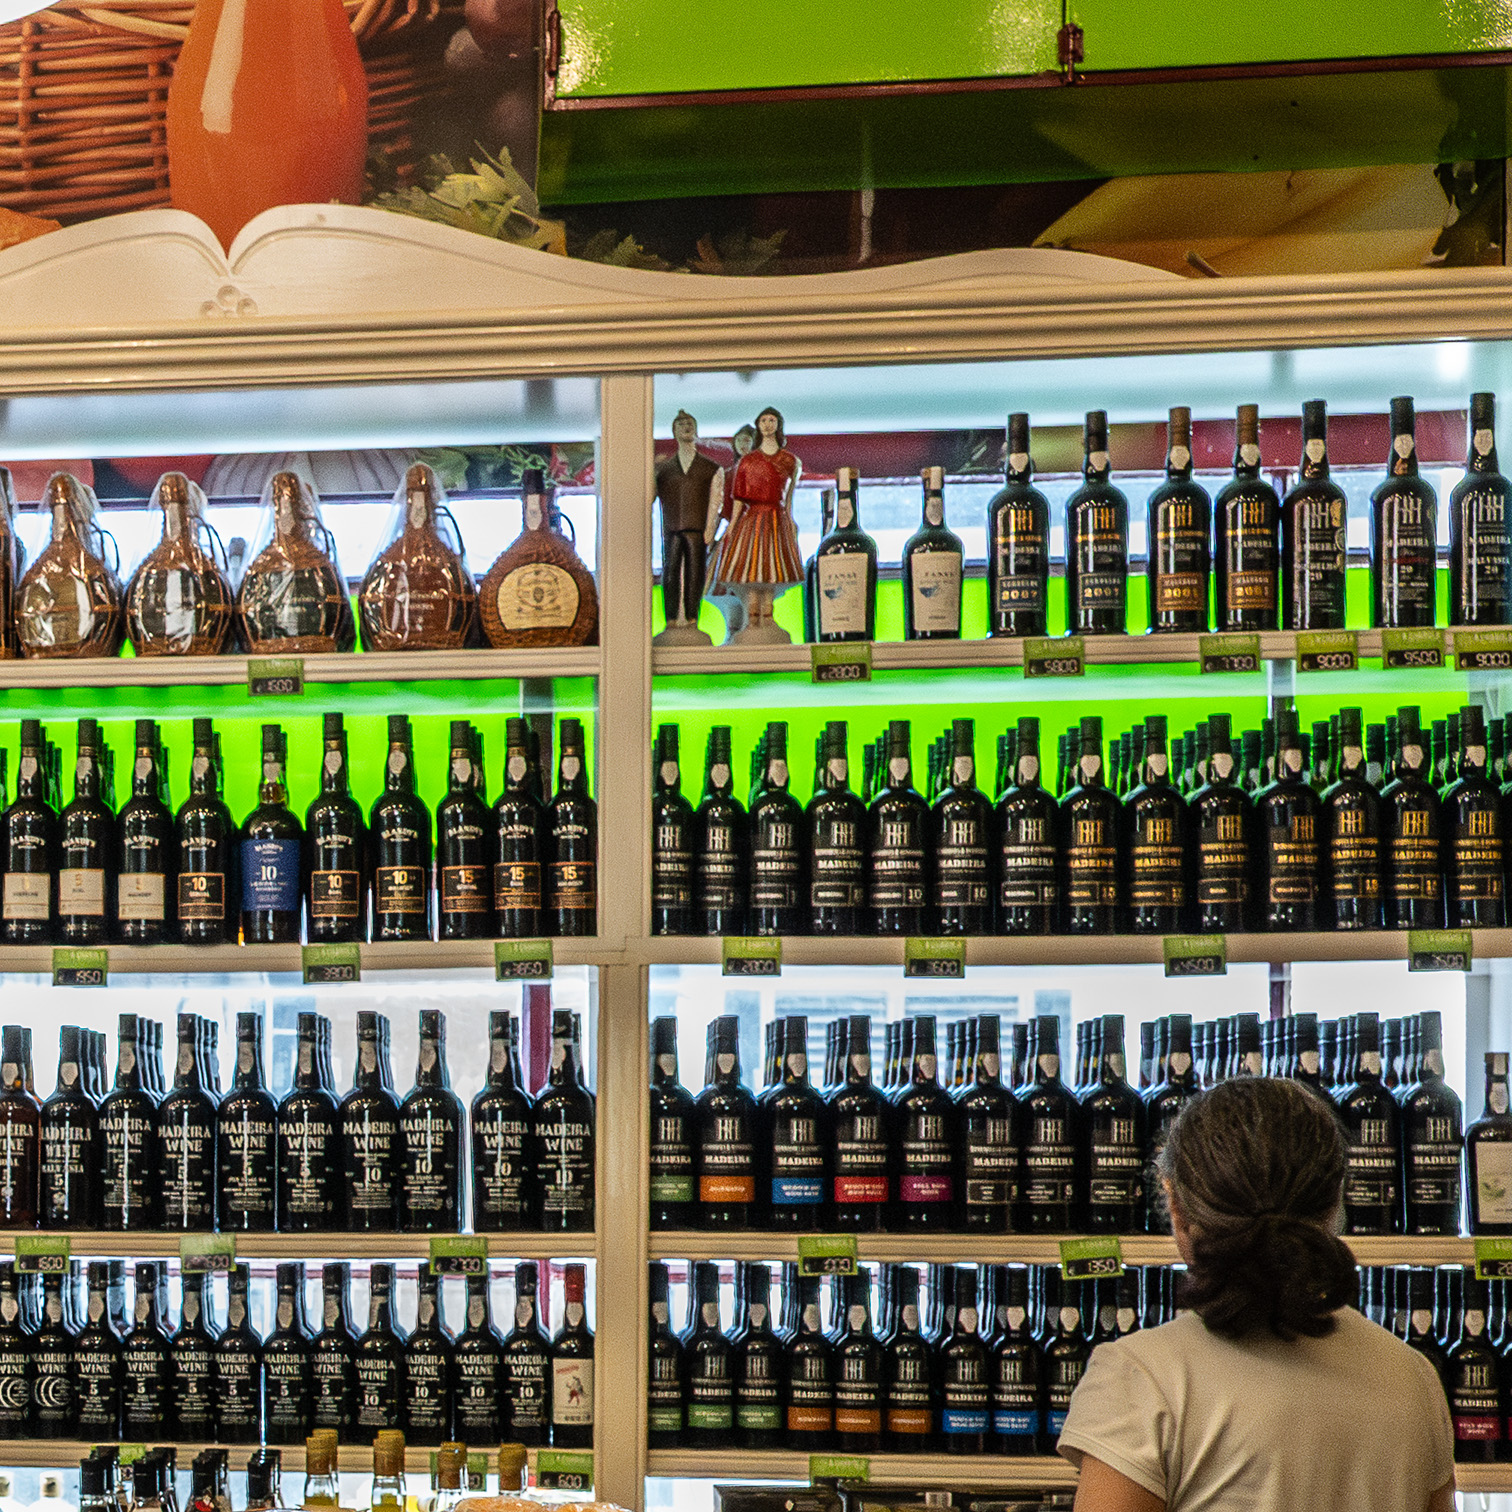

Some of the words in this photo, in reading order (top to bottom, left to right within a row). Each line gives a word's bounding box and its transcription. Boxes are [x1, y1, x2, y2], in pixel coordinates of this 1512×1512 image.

[98, 1118, 152, 1134] MADEIRA
[157, 1124, 212, 1140] MADEIRA
[219, 1120, 274, 1136] MADEIRA
[279, 1119, 334, 1136] MADEIRA
[343, 1120, 398, 1136] MADEIRA
[400, 1117, 454, 1134] MADEIRA
[475, 1119, 529, 1136] MADEIRA
[535, 1122, 591, 1138] MADEIRA
[106, 1131, 144, 1146] WINE
[165, 1138, 203, 1153] WINE
[228, 1135, 266, 1150] WINE
[287, 1135, 326, 1151] WINE
[352, 1135, 391, 1151] WINE
[406, 1131, 444, 1147] WINE
[484, 1134, 527, 1150] WINE
[544, 1138, 584, 1153] WINE
